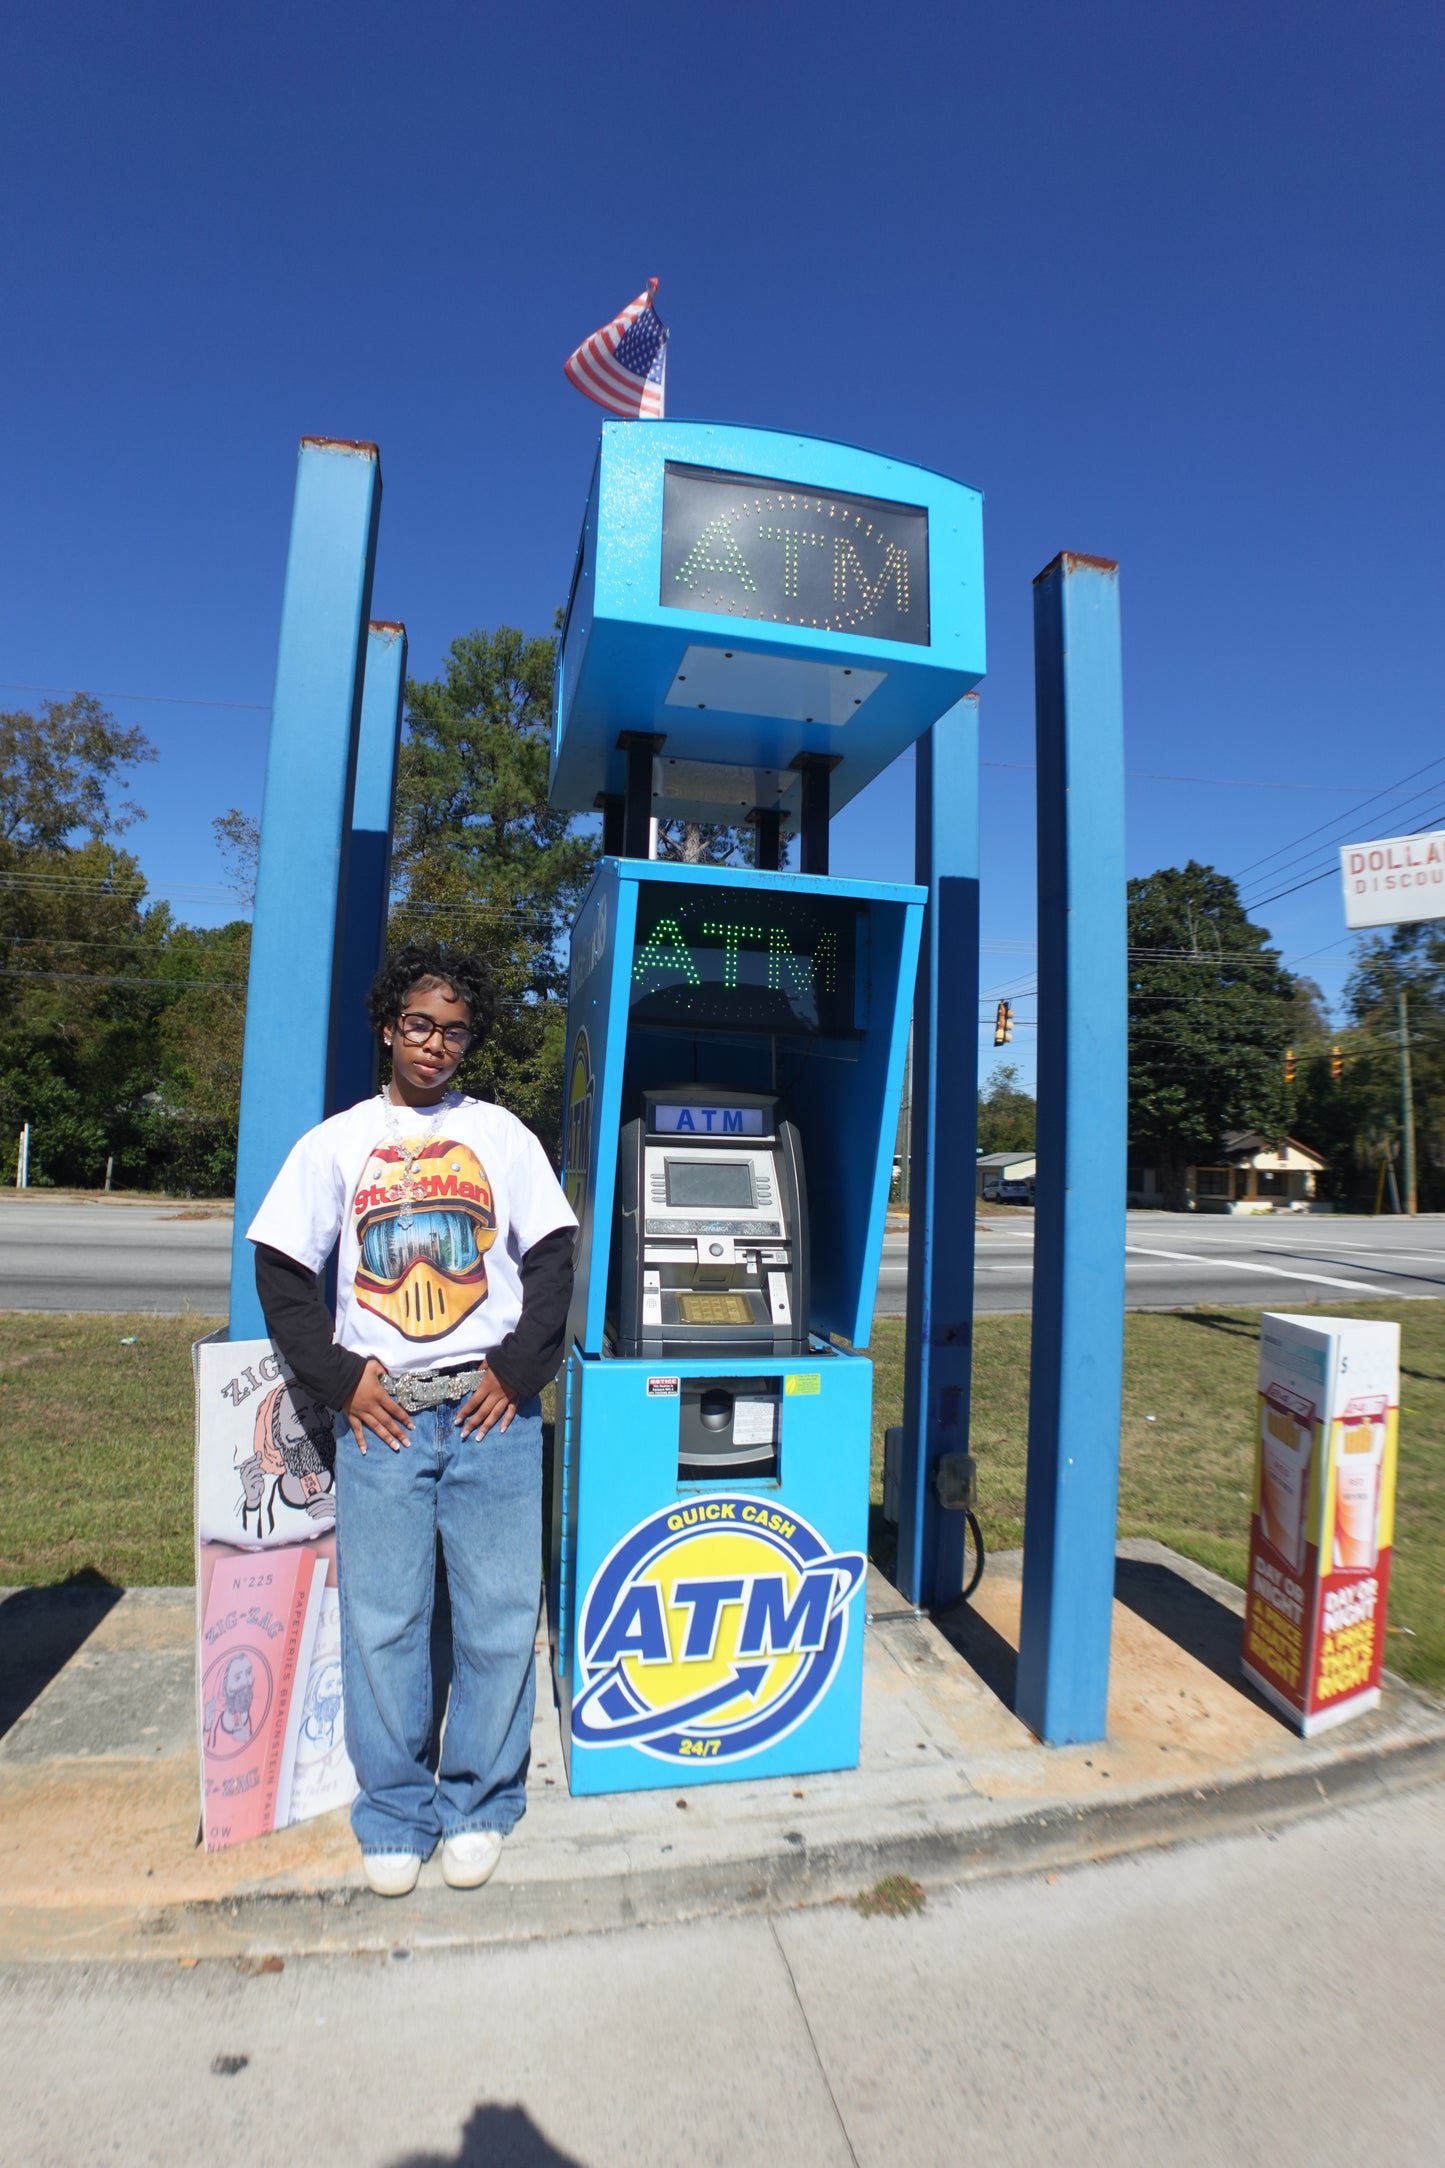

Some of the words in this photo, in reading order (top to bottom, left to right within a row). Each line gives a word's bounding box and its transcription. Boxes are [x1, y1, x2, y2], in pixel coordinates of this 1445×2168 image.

[675, 520, 909, 613] ATM
[1349, 842, 1445, 875] DOLLA
[632, 919, 837, 992] ATM
[676, 1108, 744, 1133] ATM
[649, 1378, 677, 1386] NOTICE
[667, 1503, 736, 1531] QUICK
[742, 1505, 797, 1539] CASH
[204, 1606, 285, 1646] ZIG-ZAG
[283, 1591, 305, 1681] PAPETERIES
[588, 1569, 839, 1668] ATM
[266, 1688, 288, 1785] BRAUNSTEIN
[679, 1739, 722, 1757] 24/7
